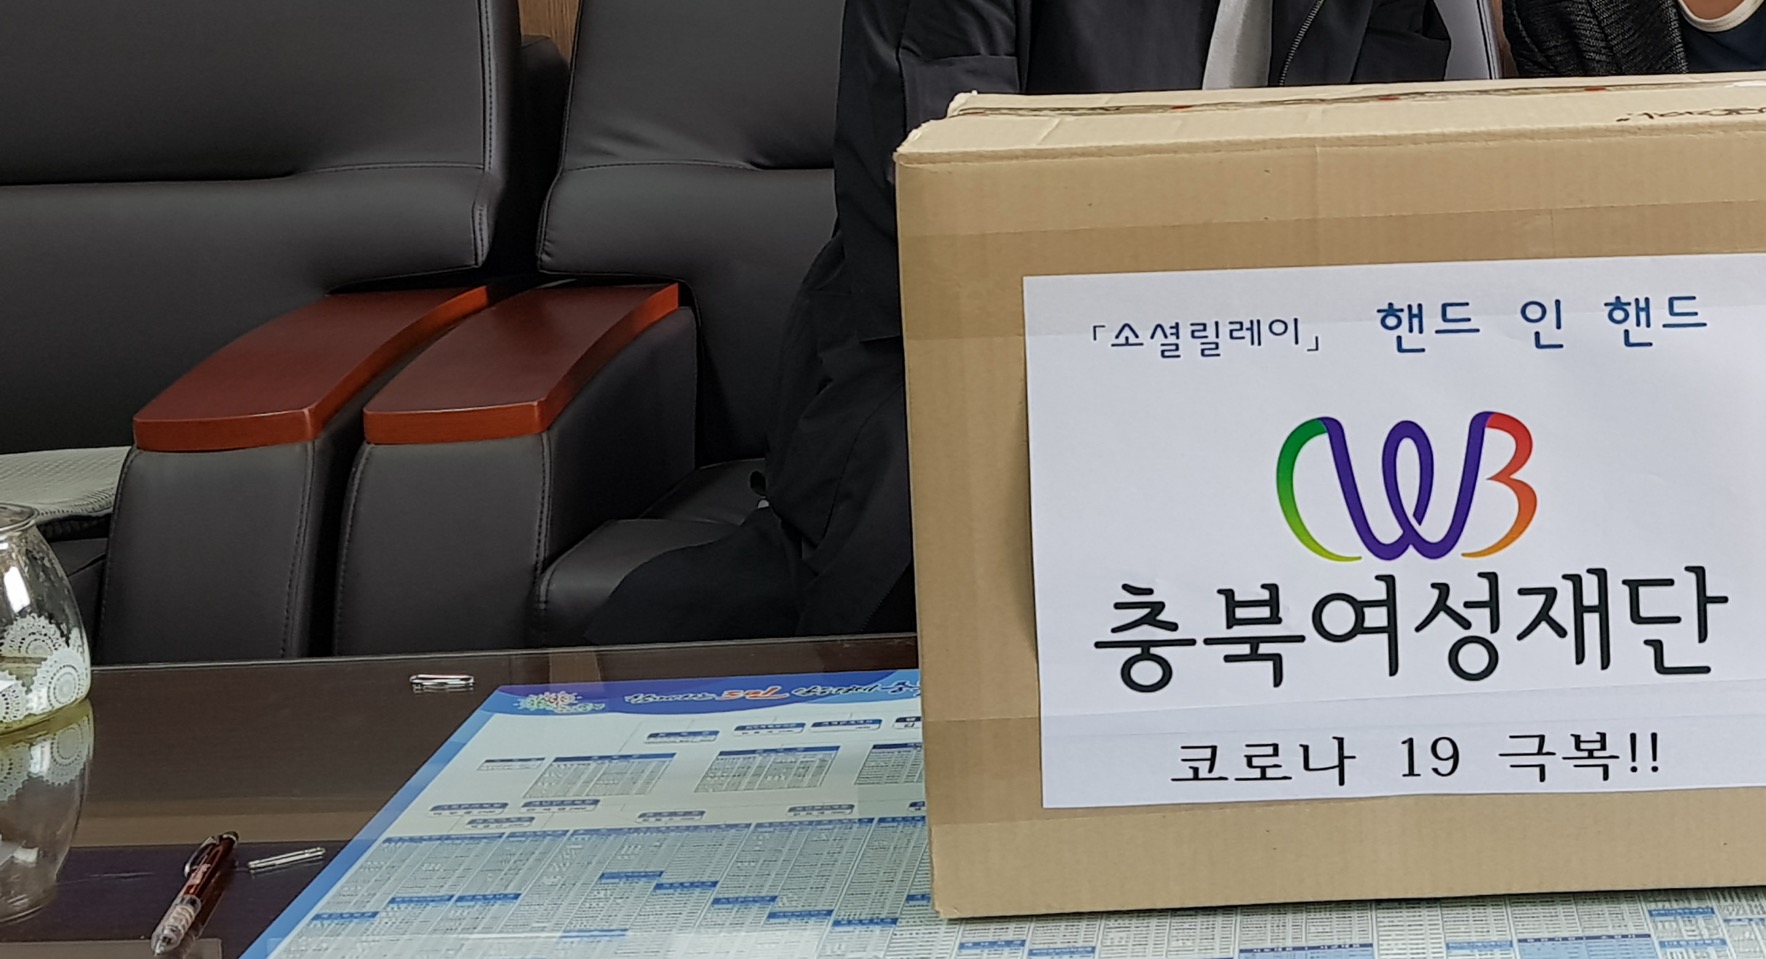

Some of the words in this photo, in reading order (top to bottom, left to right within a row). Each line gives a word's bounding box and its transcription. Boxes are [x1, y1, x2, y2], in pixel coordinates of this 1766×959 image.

[1376, 301, 1481, 354] 핸드
[1519, 298, 1564, 350] 인
[1603, 295, 1708, 348] 핸드
[1093, 565, 1730, 694] 충북여성재단
[1170, 736, 1357, 787] 코로나
[1401, 736, 1460, 778] 19
[1498, 731, 1659, 783] 극복!!
